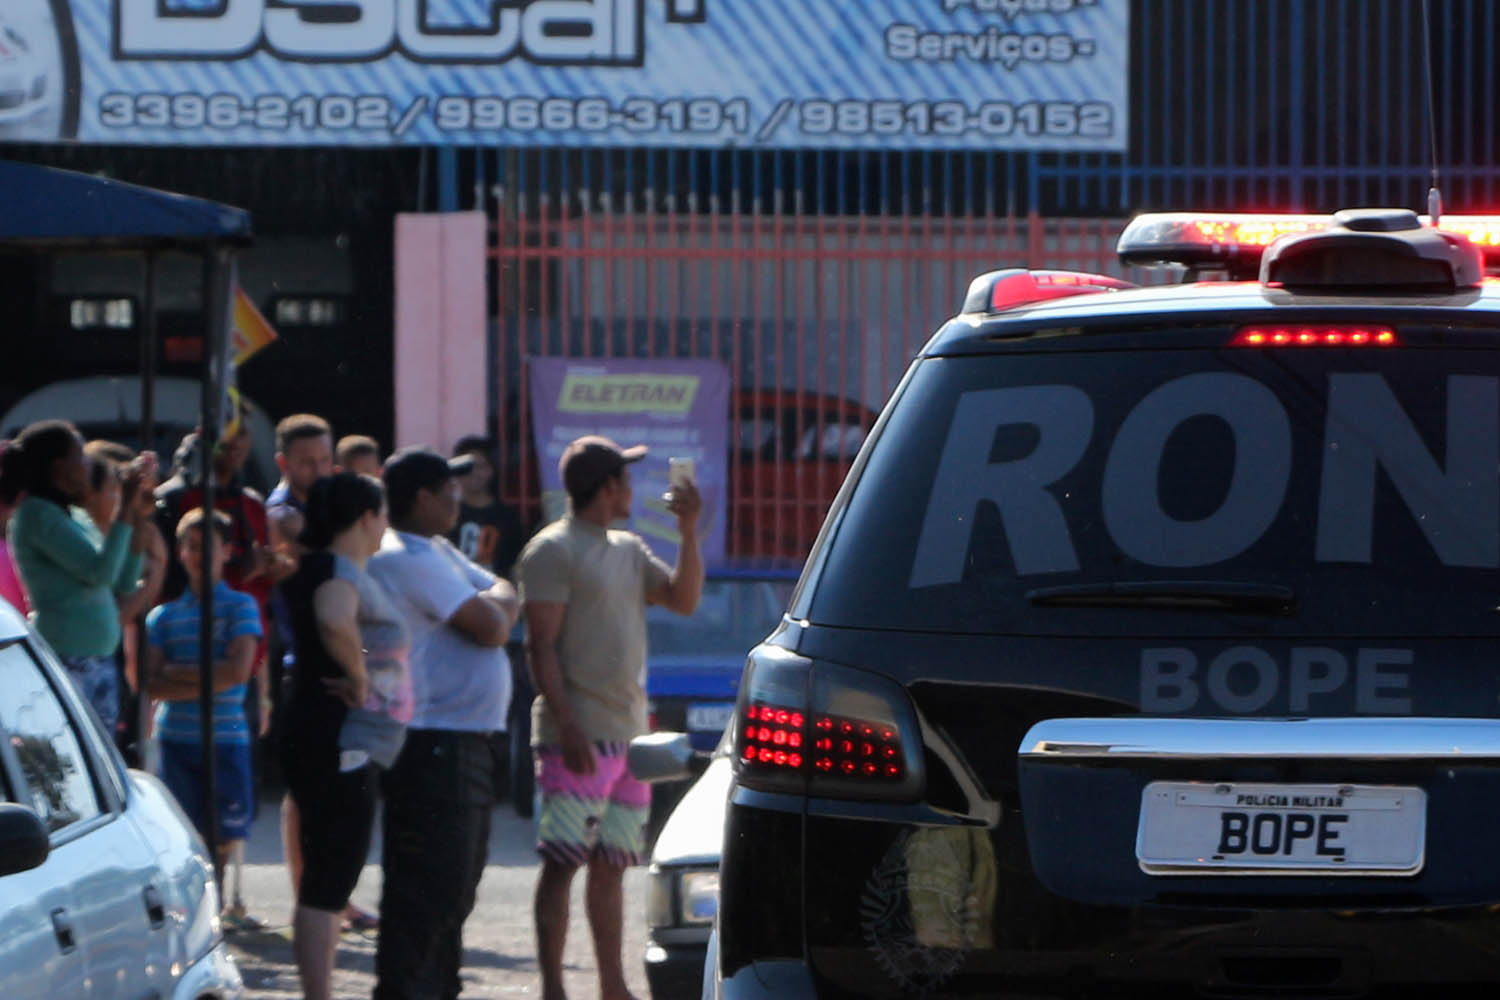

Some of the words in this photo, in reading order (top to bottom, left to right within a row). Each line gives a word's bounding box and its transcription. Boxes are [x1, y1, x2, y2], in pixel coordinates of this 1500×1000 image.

[100, 93, 391, 132] 3396-2102
[434, 95, 749, 135] 99666-3191
[801, 99, 1115, 138] 98513-0152
[1139, 646, 1416, 714] BOPE
[1216, 811, 1350, 856] BOPE
